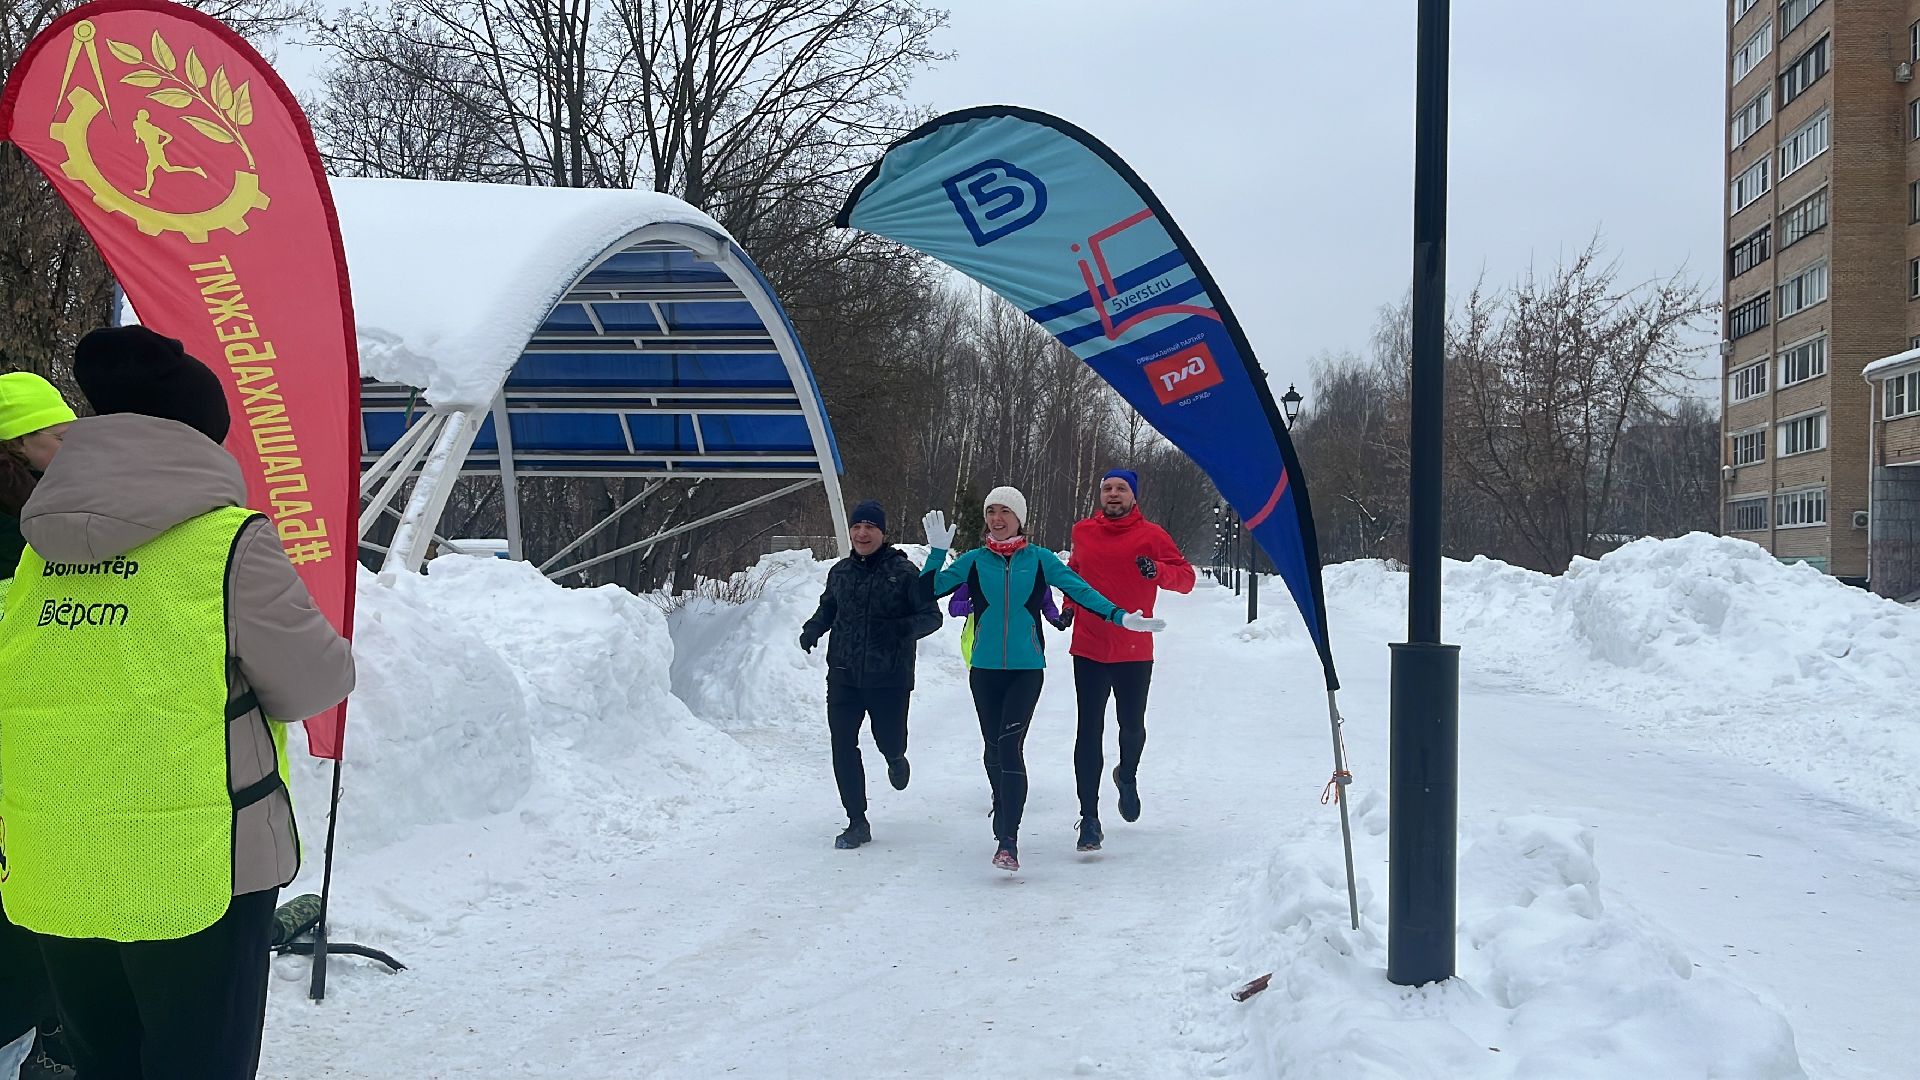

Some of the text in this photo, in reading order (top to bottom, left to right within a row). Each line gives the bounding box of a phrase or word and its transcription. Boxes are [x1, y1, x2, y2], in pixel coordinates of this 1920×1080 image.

[1111, 277, 1172, 312] 5verst.ru
[1136, 343, 1180, 365] ОФИЦИАЛЬНЫЙ
[1178, 398, 1192, 407] ОАО
[42, 555, 139, 580] Волонтёр
